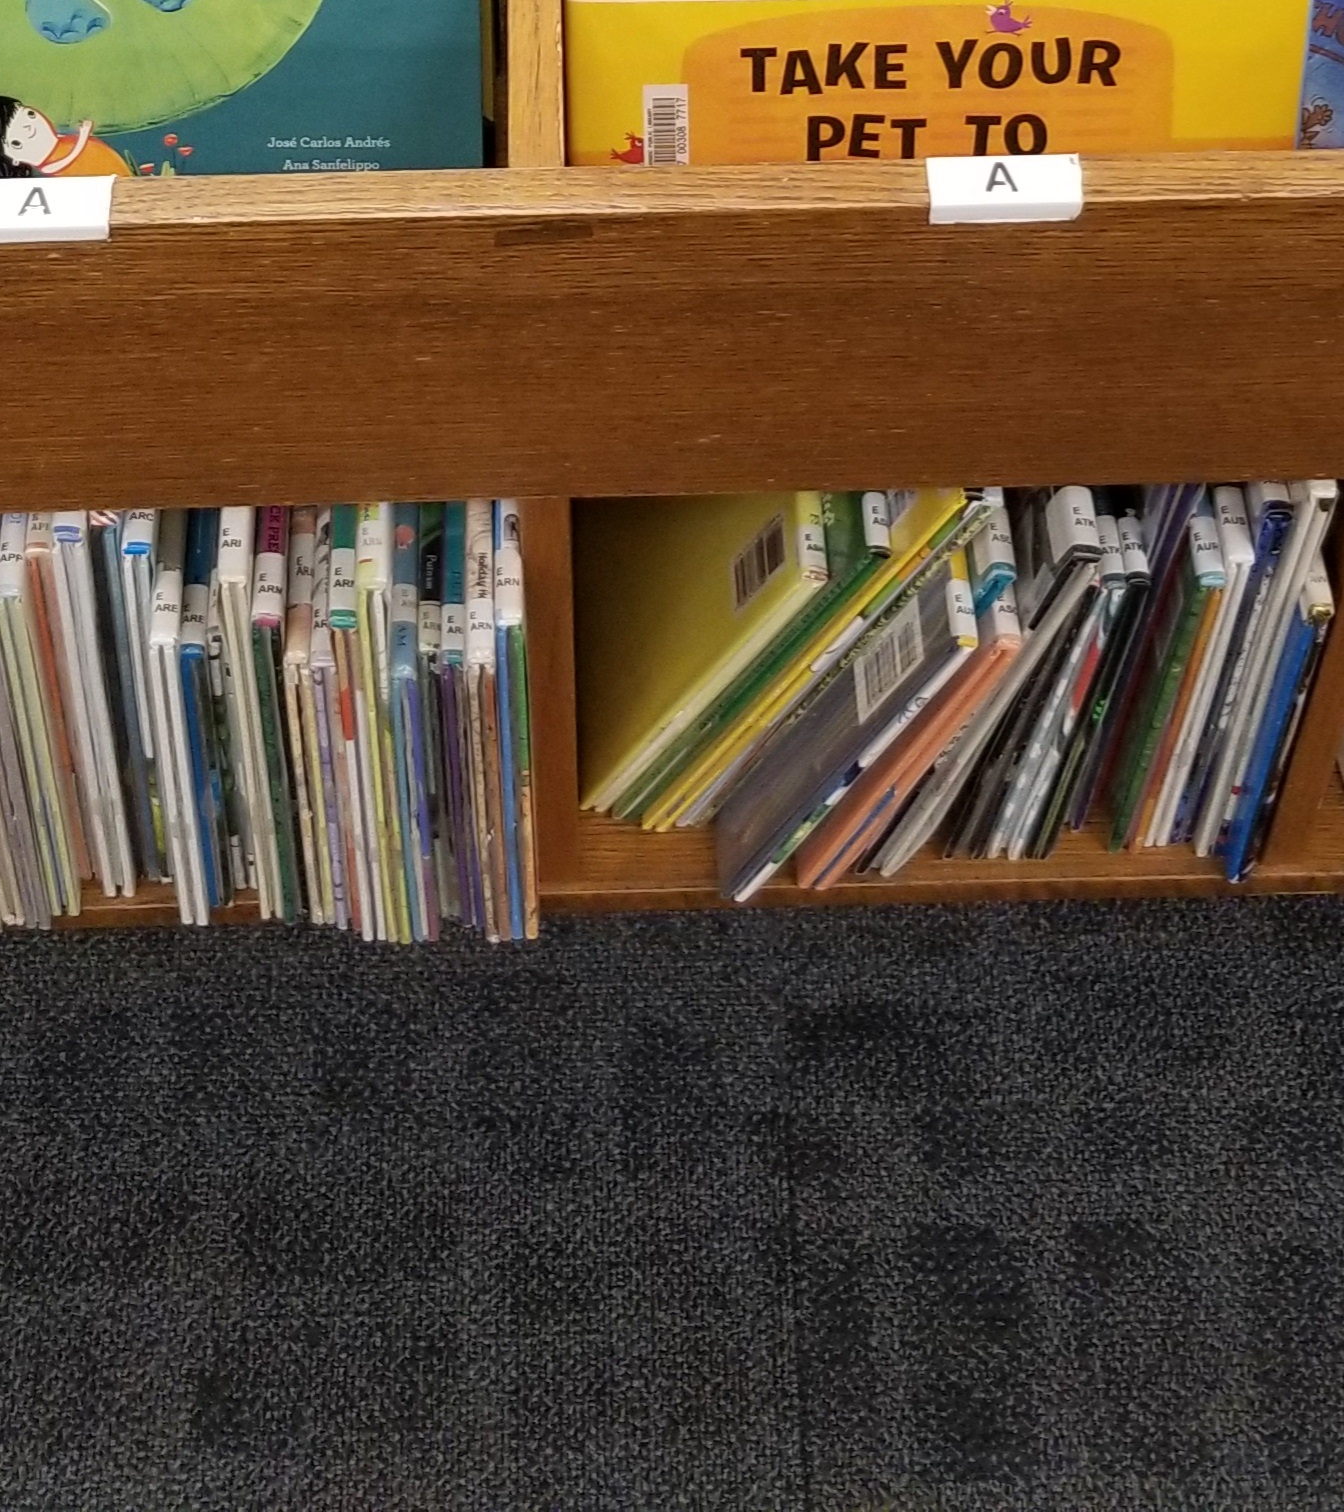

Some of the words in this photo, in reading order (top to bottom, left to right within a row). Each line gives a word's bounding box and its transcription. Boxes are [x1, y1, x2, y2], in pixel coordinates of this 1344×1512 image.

[740, 44, 907, 96] TAKE
[935, 37, 1122, 91] YOUR
[266, 136, 297, 149] José
[299, 136, 342, 149] Carlos
[344, 136, 391, 149] Andrés
[807, 114, 928, 162] PET
[965, 113, 1048, 159] TO
[282, 159, 309, 170] Ana
[311, 158, 380, 171] Sanfelippo
[984, 162, 1020, 194] A
[17, 185, 52, 217] A
[1075, 517, 1096, 528] ATK
[222, 539, 242, 548] ARI
[0, 553, 23, 563] APP
[496, 577, 520, 587] ARN
[258, 584, 282, 594] ARN
[155, 603, 179, 613] ARE
[181, 614, 204, 623] ARE
[469, 621, 493, 630] ARN
